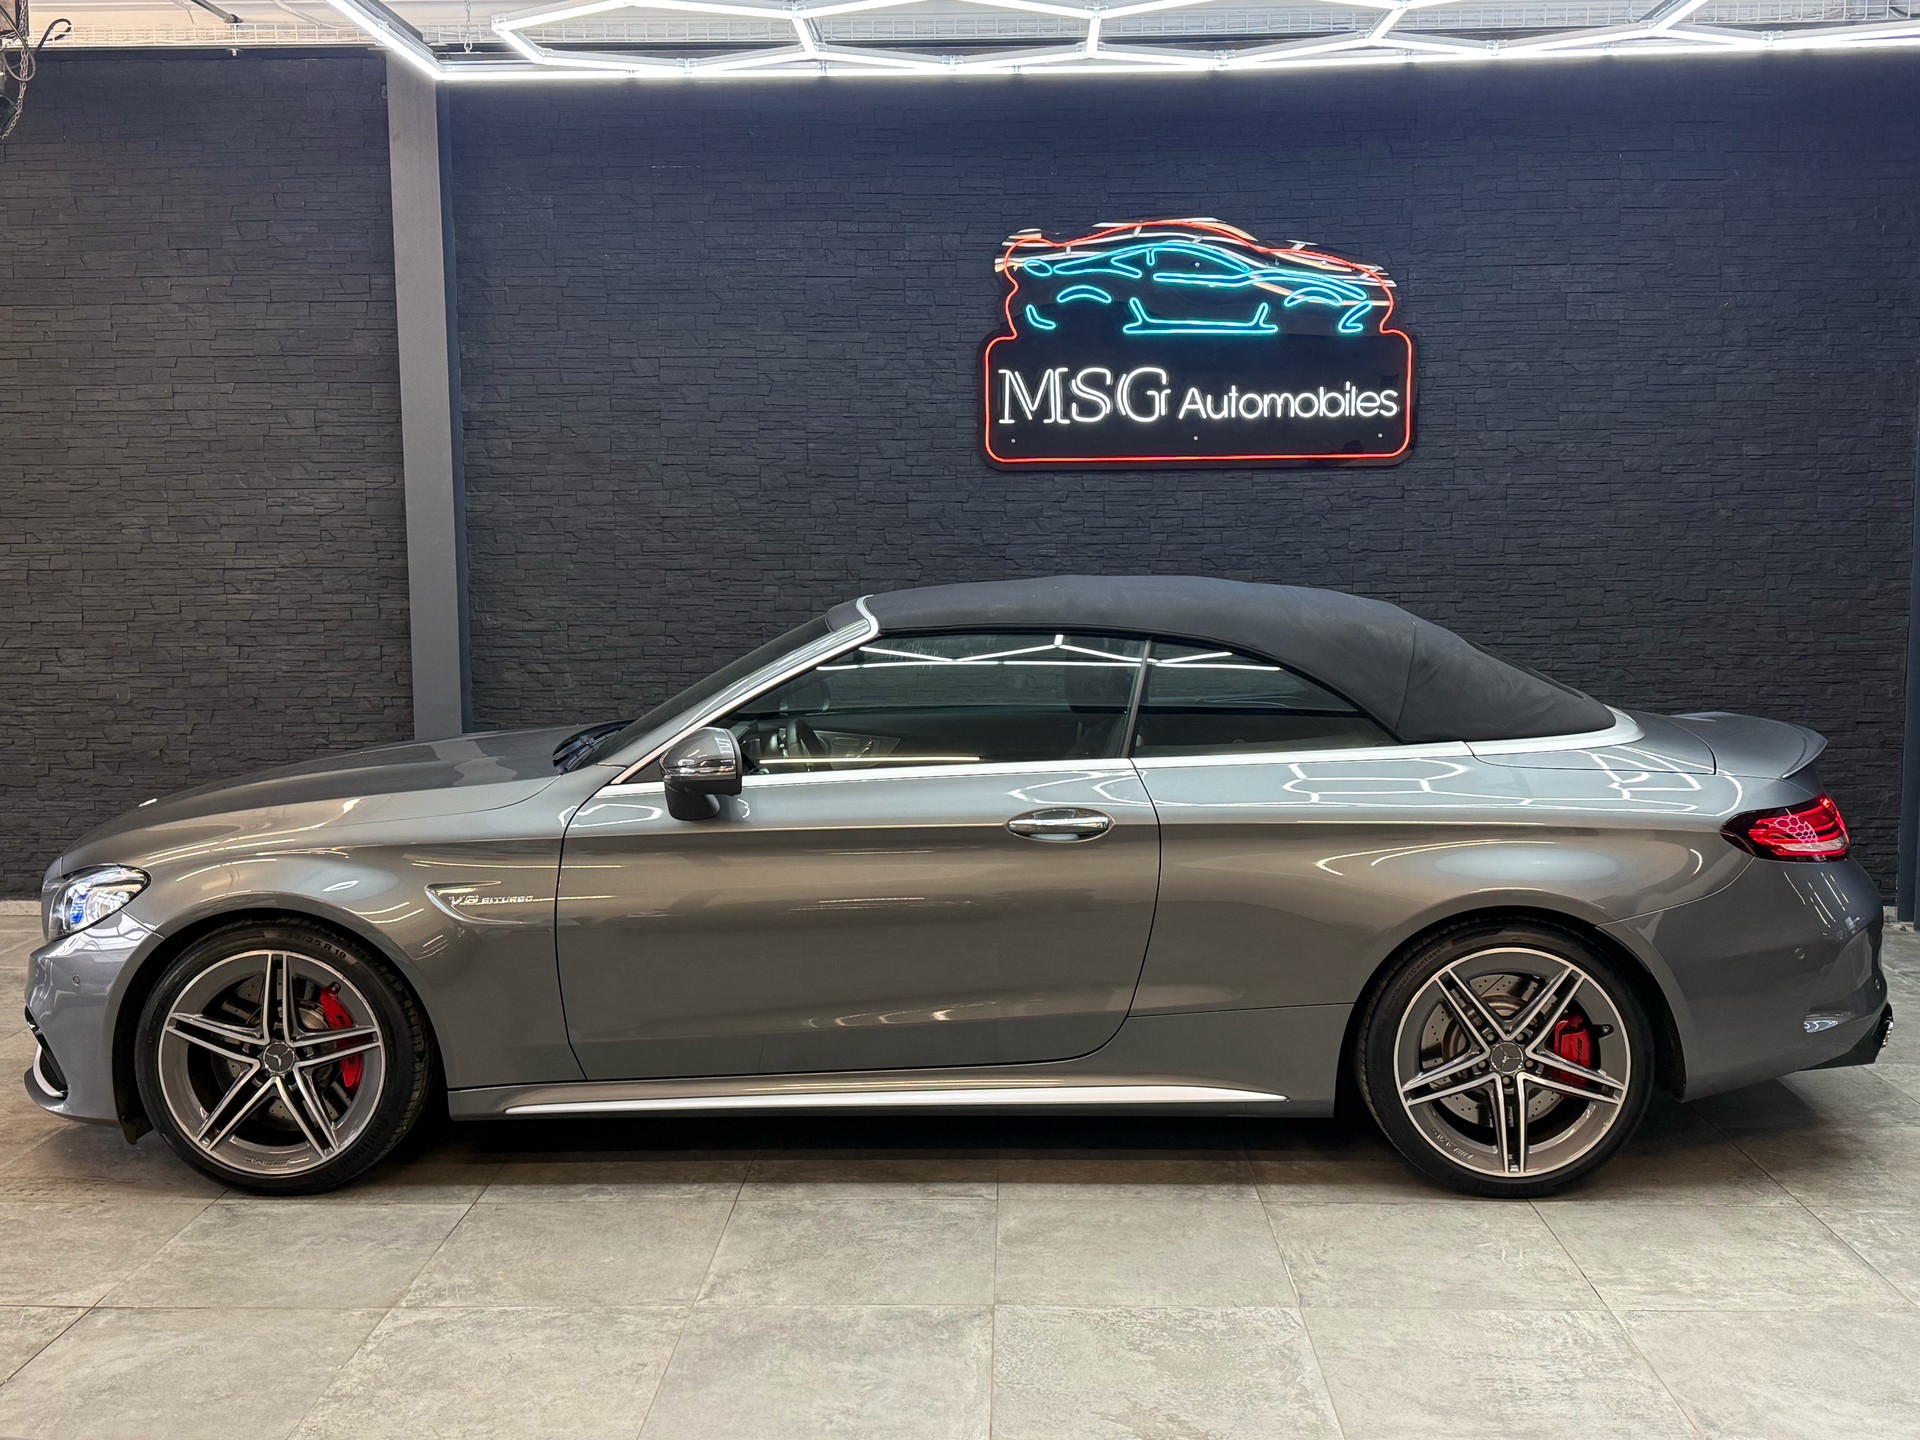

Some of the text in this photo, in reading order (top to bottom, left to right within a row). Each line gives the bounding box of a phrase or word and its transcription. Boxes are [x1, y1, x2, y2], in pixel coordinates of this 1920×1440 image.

[998, 367, 1399, 424] MSG Automobiles
[334, 949, 347, 959] 19
